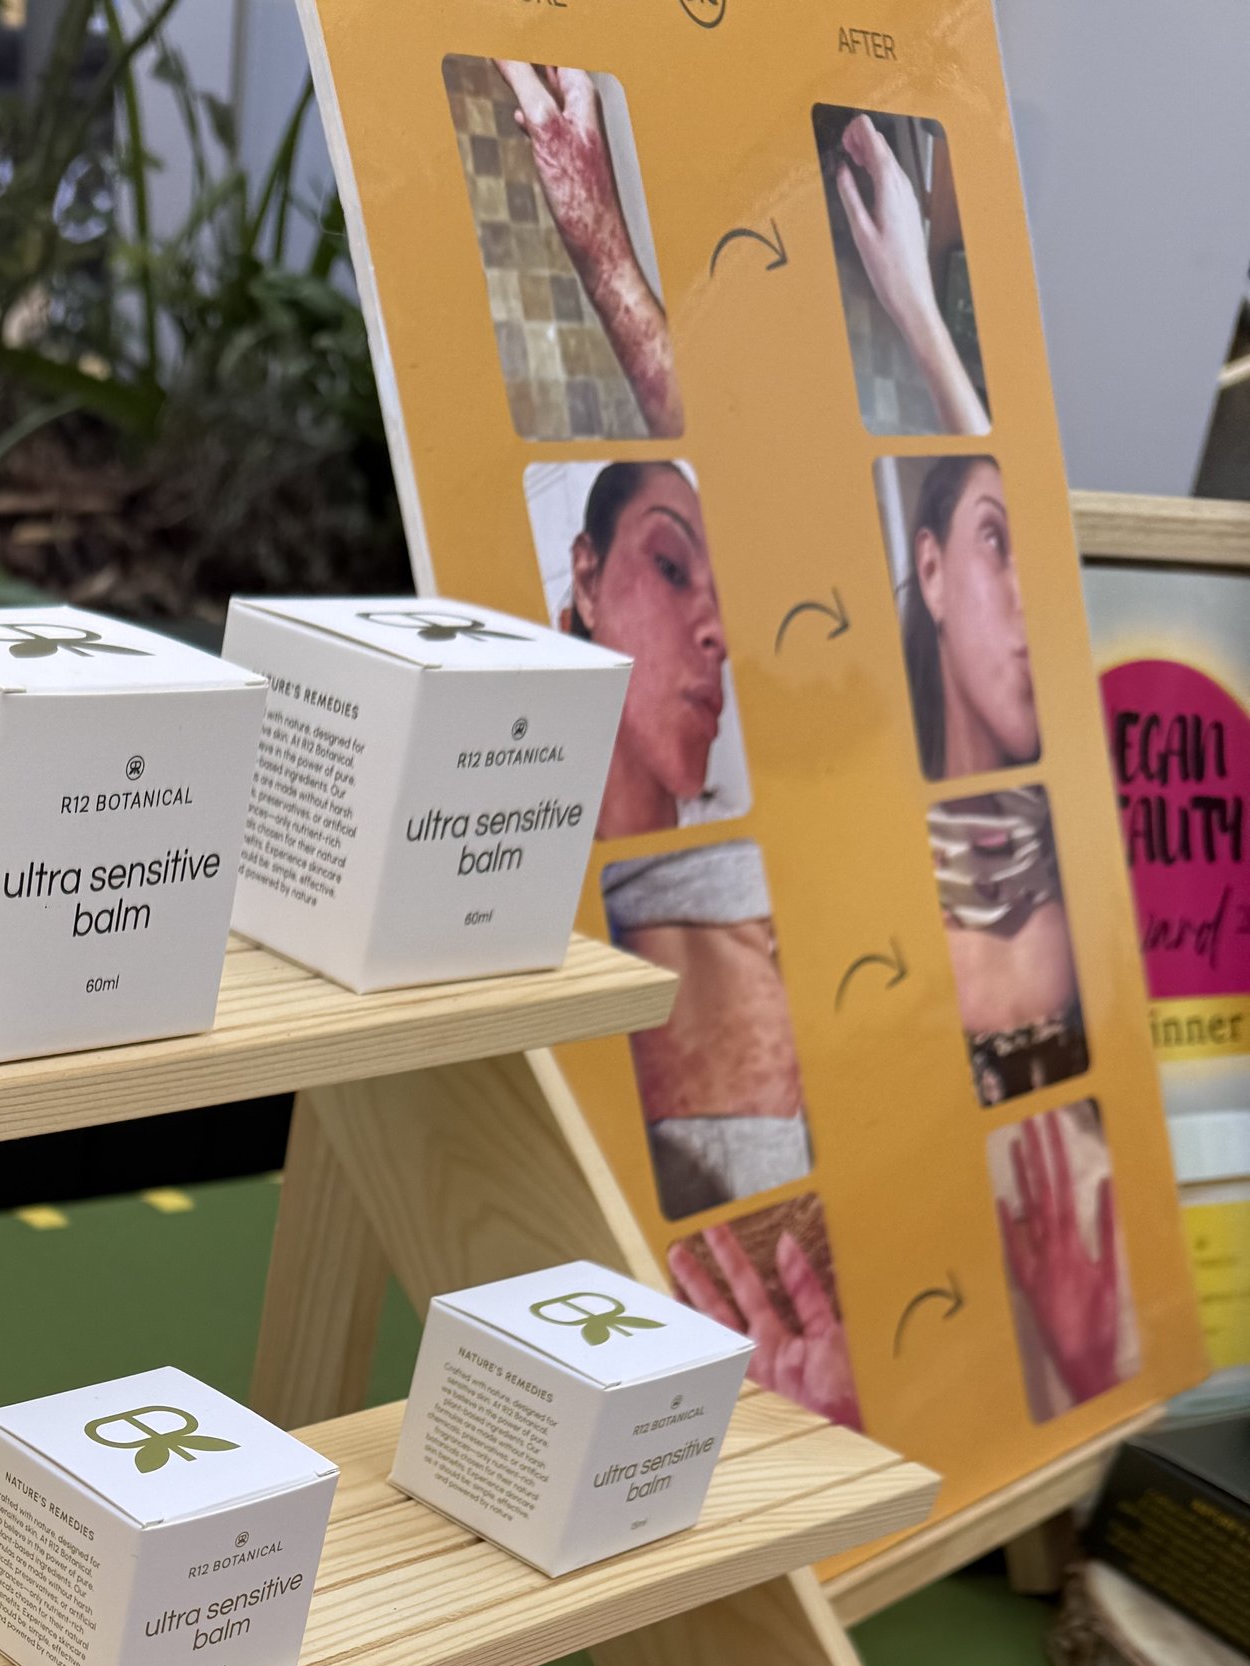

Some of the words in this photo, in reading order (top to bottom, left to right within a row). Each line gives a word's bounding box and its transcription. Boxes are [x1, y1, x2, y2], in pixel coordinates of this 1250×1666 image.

[838, 26, 897, 61] AFTER
[262, 671, 301, 699] URE'S
[302, 686, 359, 721] REMEDIES
[456, 751, 481, 768] R12
[484, 746, 563, 767] BOTANICAL
[1115, 712, 1227, 787] EGAN
[61, 795, 89, 814] R12
[96, 786, 192, 811] BOTANICAL
[406, 809, 469, 842] ultra
[474, 799, 582, 836] sensitive
[4, 861, 81, 898] ultra
[90, 848, 220, 891] sensitive
[457, 842, 523, 875] balm
[72, 898, 150, 937] balm
[464, 909, 493, 925] 60ml
[86, 973, 119, 993] 60ml
[1150, 1008, 1243, 1050] inner
[458, 1347, 503, 1376] NATURE'S
[504, 1371, 553, 1403] REMEDIES
[594, 1463, 638, 1488] ultra
[639, 1437, 715, 1475] sensitive
[5, 1471, 46, 1507] NATURE'S
[49, 1502, 94, 1541] REMEDIES
[626, 1475, 672, 1502] balm
[188, 1563, 209, 1578] R12
[213, 1541, 283, 1571] BOTANICAL
[145, 1607, 201, 1637] ultra
[206, 1573, 303, 1619] sensitive
[192, 1618, 250, 1650] balm
